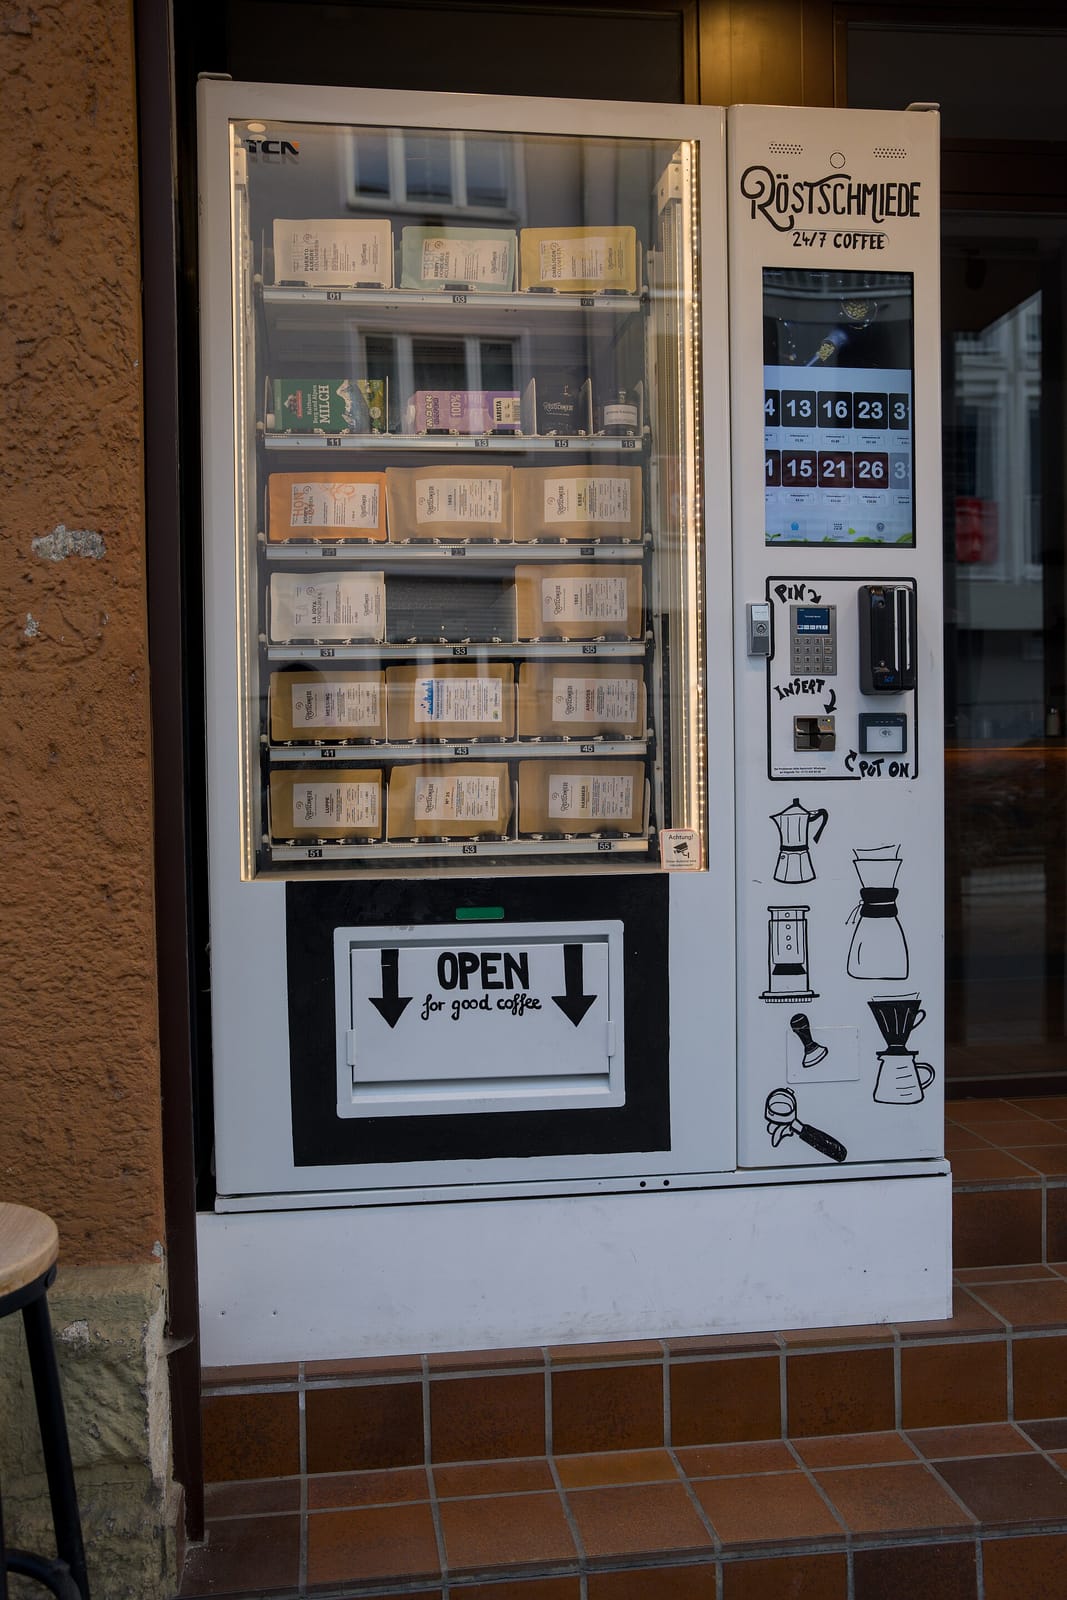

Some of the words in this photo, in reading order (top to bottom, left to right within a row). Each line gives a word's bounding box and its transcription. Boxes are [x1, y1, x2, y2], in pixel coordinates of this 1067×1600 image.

[740, 165, 921, 232] RÖSTSCHMIEDE
[793, 232, 826, 247] 24/7
[834, 233, 885, 249] COFFEE
[329, 292, 340, 300] 01
[319, 385, 330, 424] MILCH
[786, 399, 811, 417] 13
[823, 400, 847, 418] 16
[858, 401, 883, 419] 23
[894, 403, 909, 419] 3
[787, 460, 812, 477] 15
[823, 460, 845, 477] 21
[859, 461, 884, 478] 26
[895, 462, 909, 479] 3
[775, 584, 806, 603] PIN
[773, 678, 825, 700] INSERT
[859, 759, 884, 778] PUT
[889, 761, 910, 777] ON
[600, 842, 610, 850] 55
[437, 952, 529, 990] OPEN
[421, 994, 445, 1020] for
[451, 994, 492, 1020] good
[497, 993, 542, 1016] coffee
